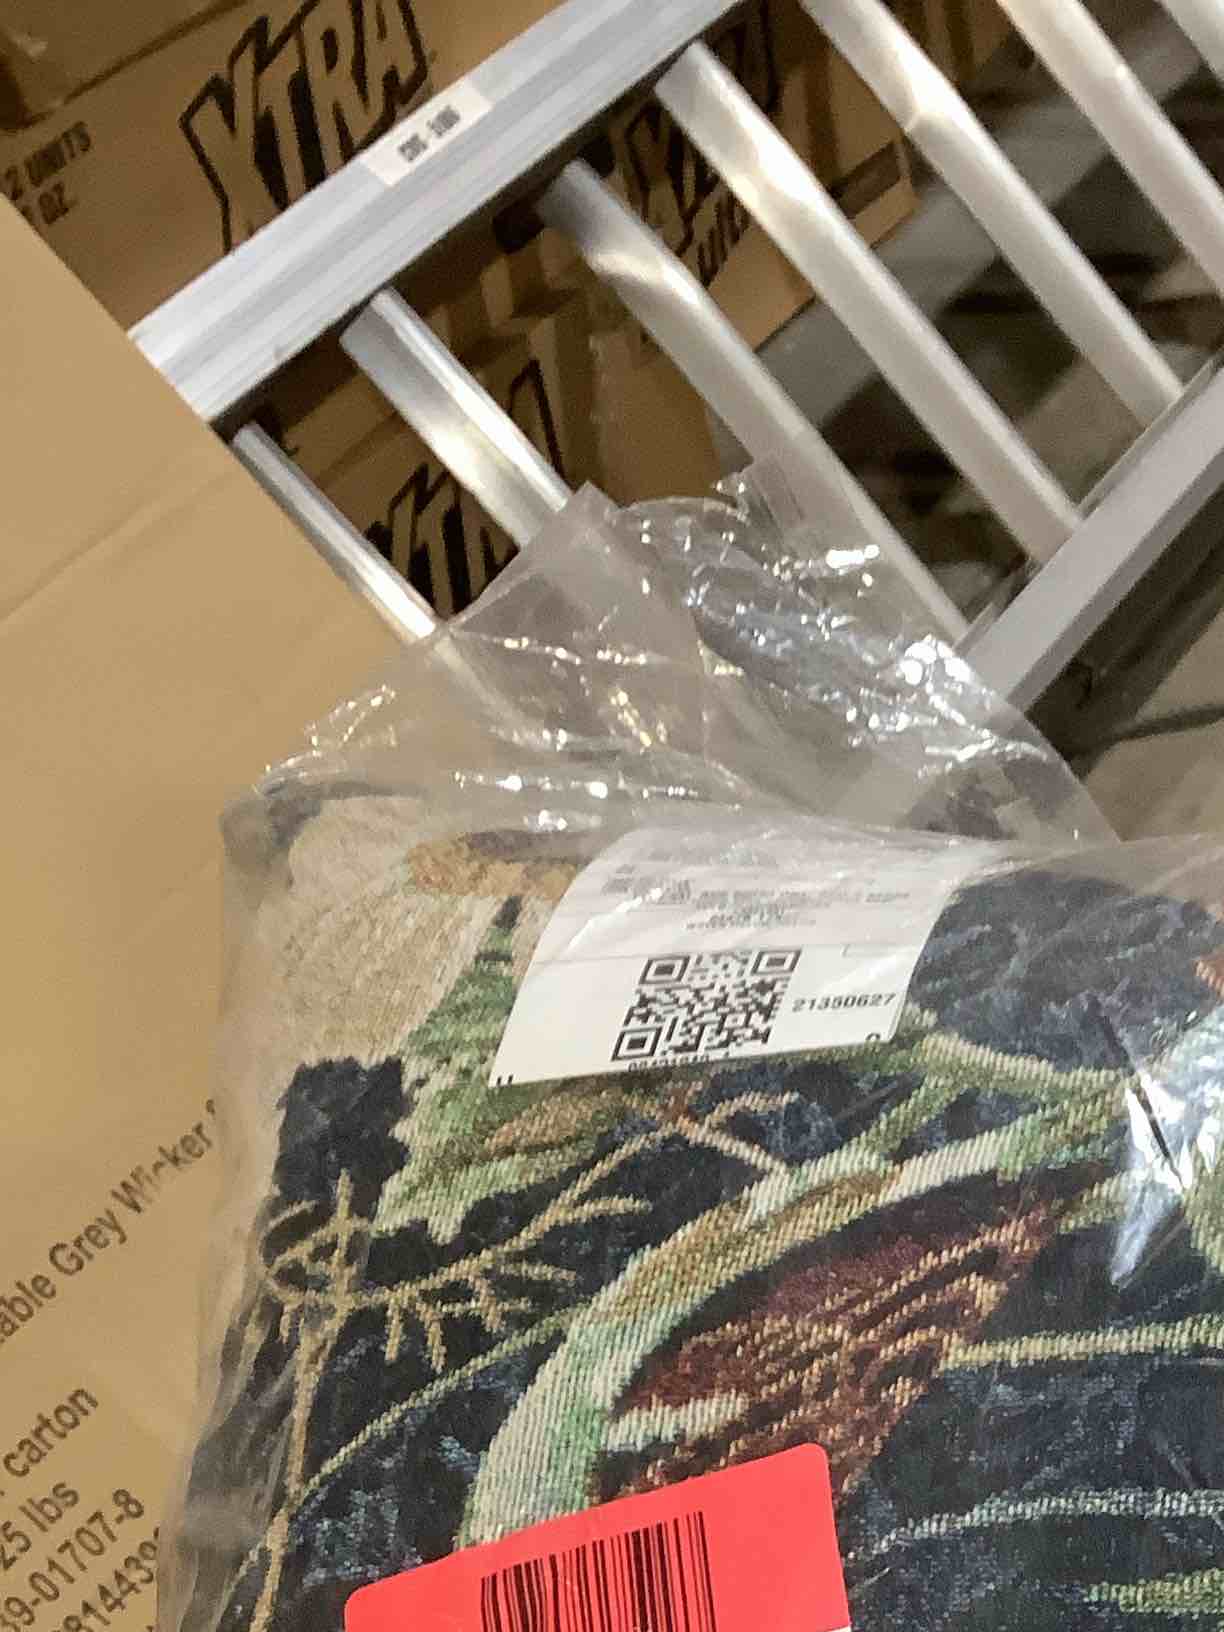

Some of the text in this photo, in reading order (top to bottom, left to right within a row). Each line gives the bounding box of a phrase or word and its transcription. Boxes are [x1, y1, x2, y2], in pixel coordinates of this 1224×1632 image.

[0, 1274, 57, 1345] able
[49, 1207, 127, 1276] Grey
[3, 1387, 98, 1478] carton
[18, 1481, 80, 1533] lbs
